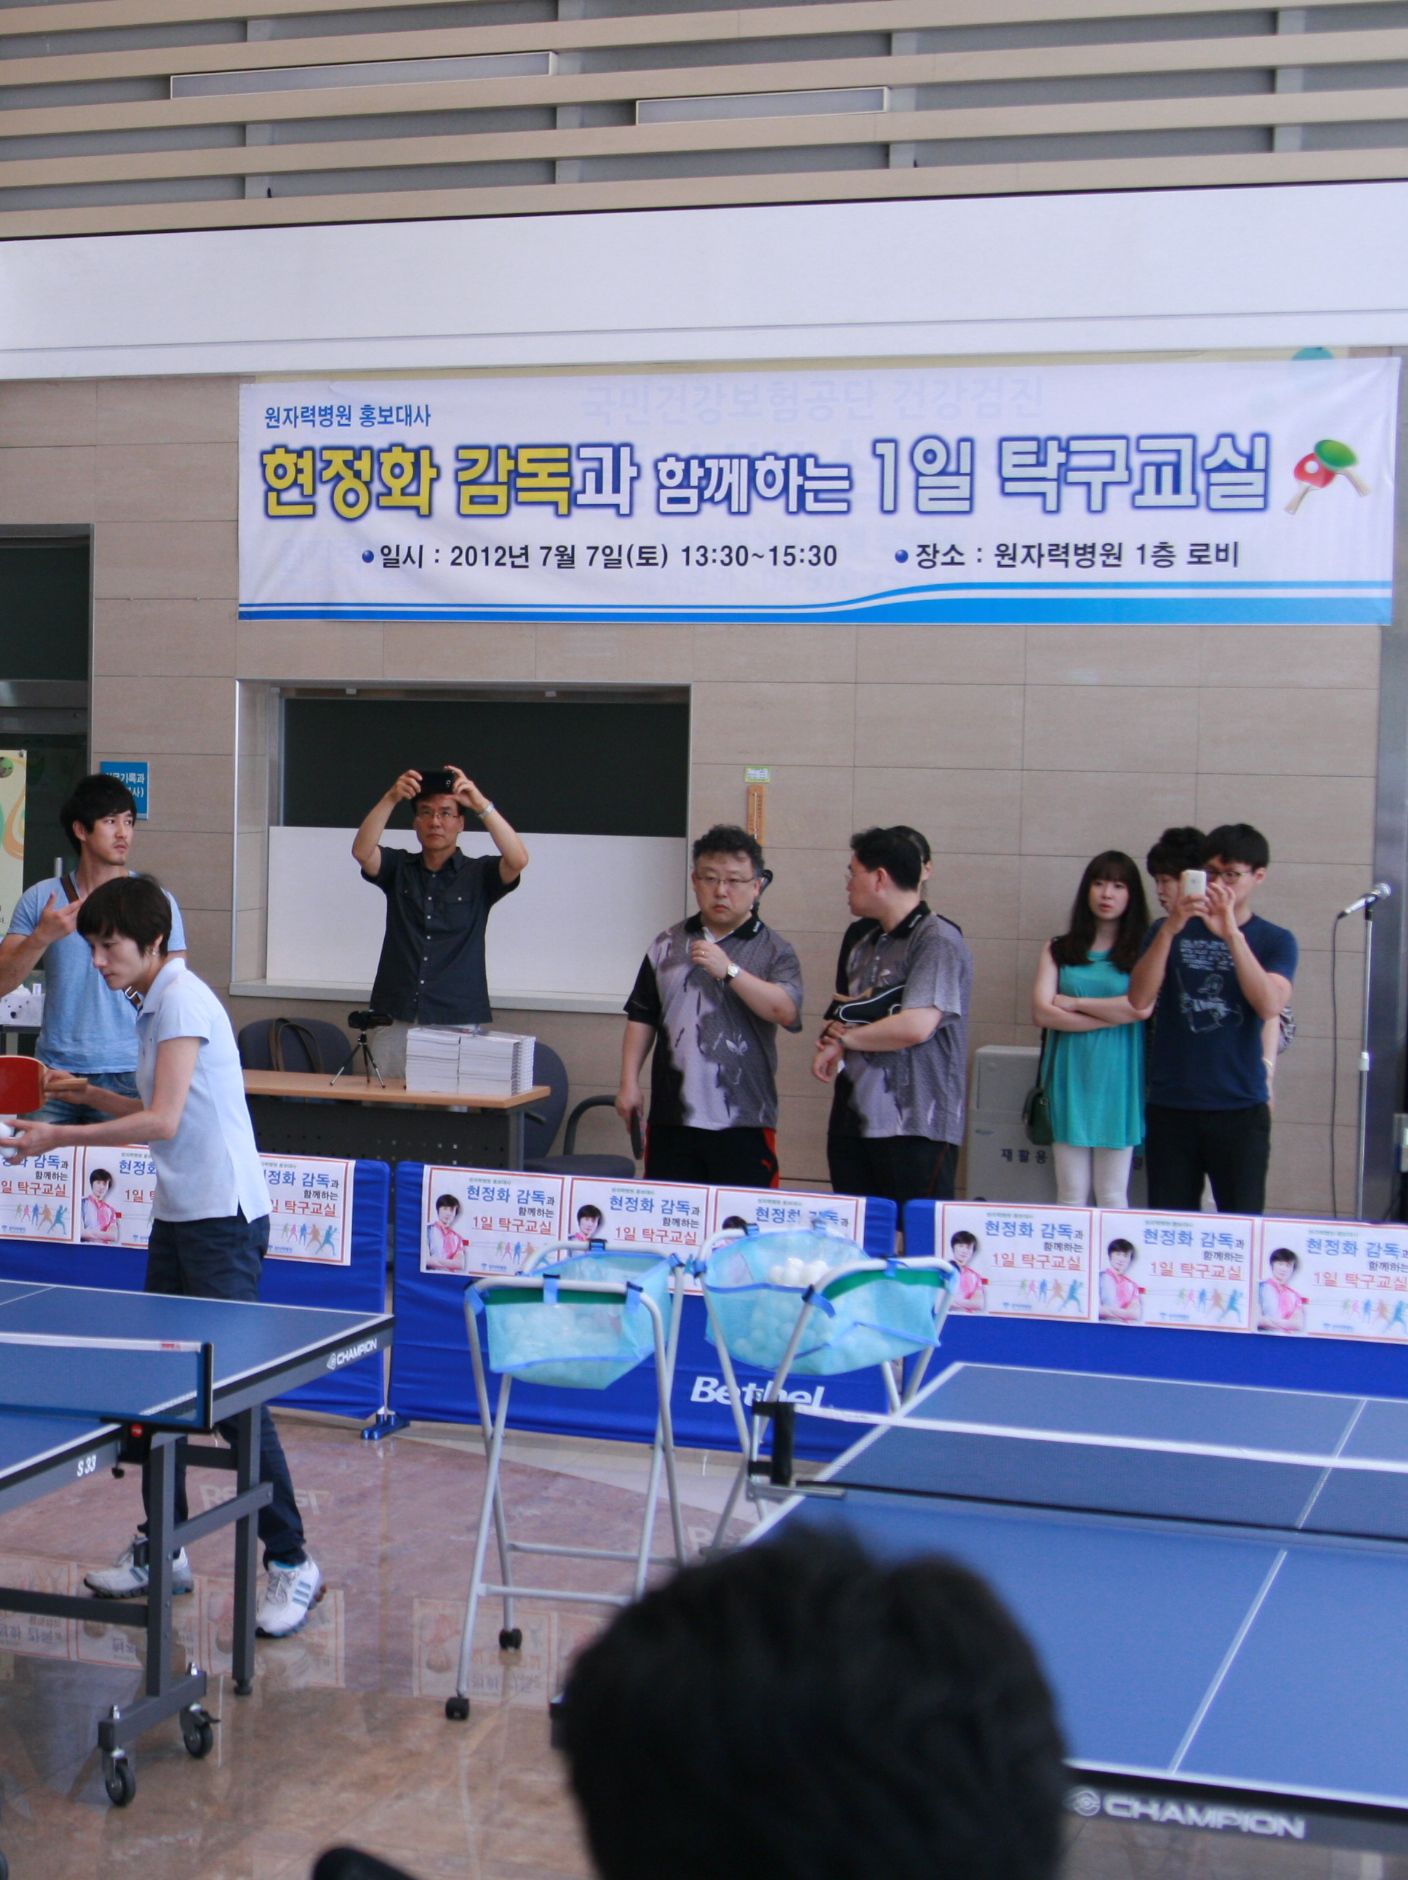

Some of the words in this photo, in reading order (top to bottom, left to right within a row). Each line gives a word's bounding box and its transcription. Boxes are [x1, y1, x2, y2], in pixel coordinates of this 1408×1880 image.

[264, 404, 353, 430] 원자력병원
[359, 403, 432, 429] 홍보대사
[261, 443, 439, 520] 현정화
[455, 442, 639, 518] 감독과
[656, 449, 853, 517] 함께하는
[872, 434, 975, 516] 1일
[997, 431, 1272, 515] 탁구교실
[380, 544, 425, 570] 일시
[450, 544, 531, 569] 2012년
[540, 544, 577, 569] 7월
[587, 543, 669, 570] 7일(토)
[680, 545, 838, 568] 13:30~15:30
[916, 542, 965, 569] 장소
[994, 541, 1123, 569] 원자력병원
[1135, 541, 1177, 569] 1층
[1187, 541, 1240, 568] 로비
[105, 772, 145, 785] 기록과
[35, 1170, 69, 1182] 함께하는
[263, 1170, 296, 1186] 정화
[302, 1172, 339, 1189] 감독과
[17, 1181, 67, 1198] 탁구교실
[125, 1188, 144, 1203] 1일
[303, 1189, 339, 1200] 함께하는
[467, 1184, 511, 1203] 현정화
[516, 1189, 555, 1206] 감독과
[284, 1200, 336, 1217] 탁구교실
[518, 1206, 555, 1219] 함께하는
[609, 1195, 655, 1213] 현정화
[660, 1199, 700, 1216] 감독과
[473, 1216, 493, 1231] 1일
[498, 1217, 552, 1235] 탁구교실
[662, 1218, 700, 1229] 함께하는
[985, 1220, 1034, 1238] 현정화
[1040, 1223, 1084, 1240] 감독과
[615, 1226, 638, 1242] 1일
[642, 1228, 697, 1246] 탁구교실
[1143, 1228, 1194, 1247] 현정화
[1200, 1232, 1245, 1249] 감독과
[1044, 1242, 1084, 1253] 함께하는
[1203, 1251, 1244, 1263] 함께하는
[1306, 1238, 1358, 1257] 현정화
[993, 1253, 1015, 1268] 1일
[1022, 1254, 1081, 1271] 탁구교실
[1151, 1262, 1174, 1277] 1일
[1180, 1263, 1242, 1280] 탁구교실
[1314, 1272, 1338, 1287] 1일
[1345, 1272, 1408, 1291] 탁구교실
[336, 1337, 378, 1366] CHAMPION
[1102, 1795, 1307, 1840] CHAMPION
